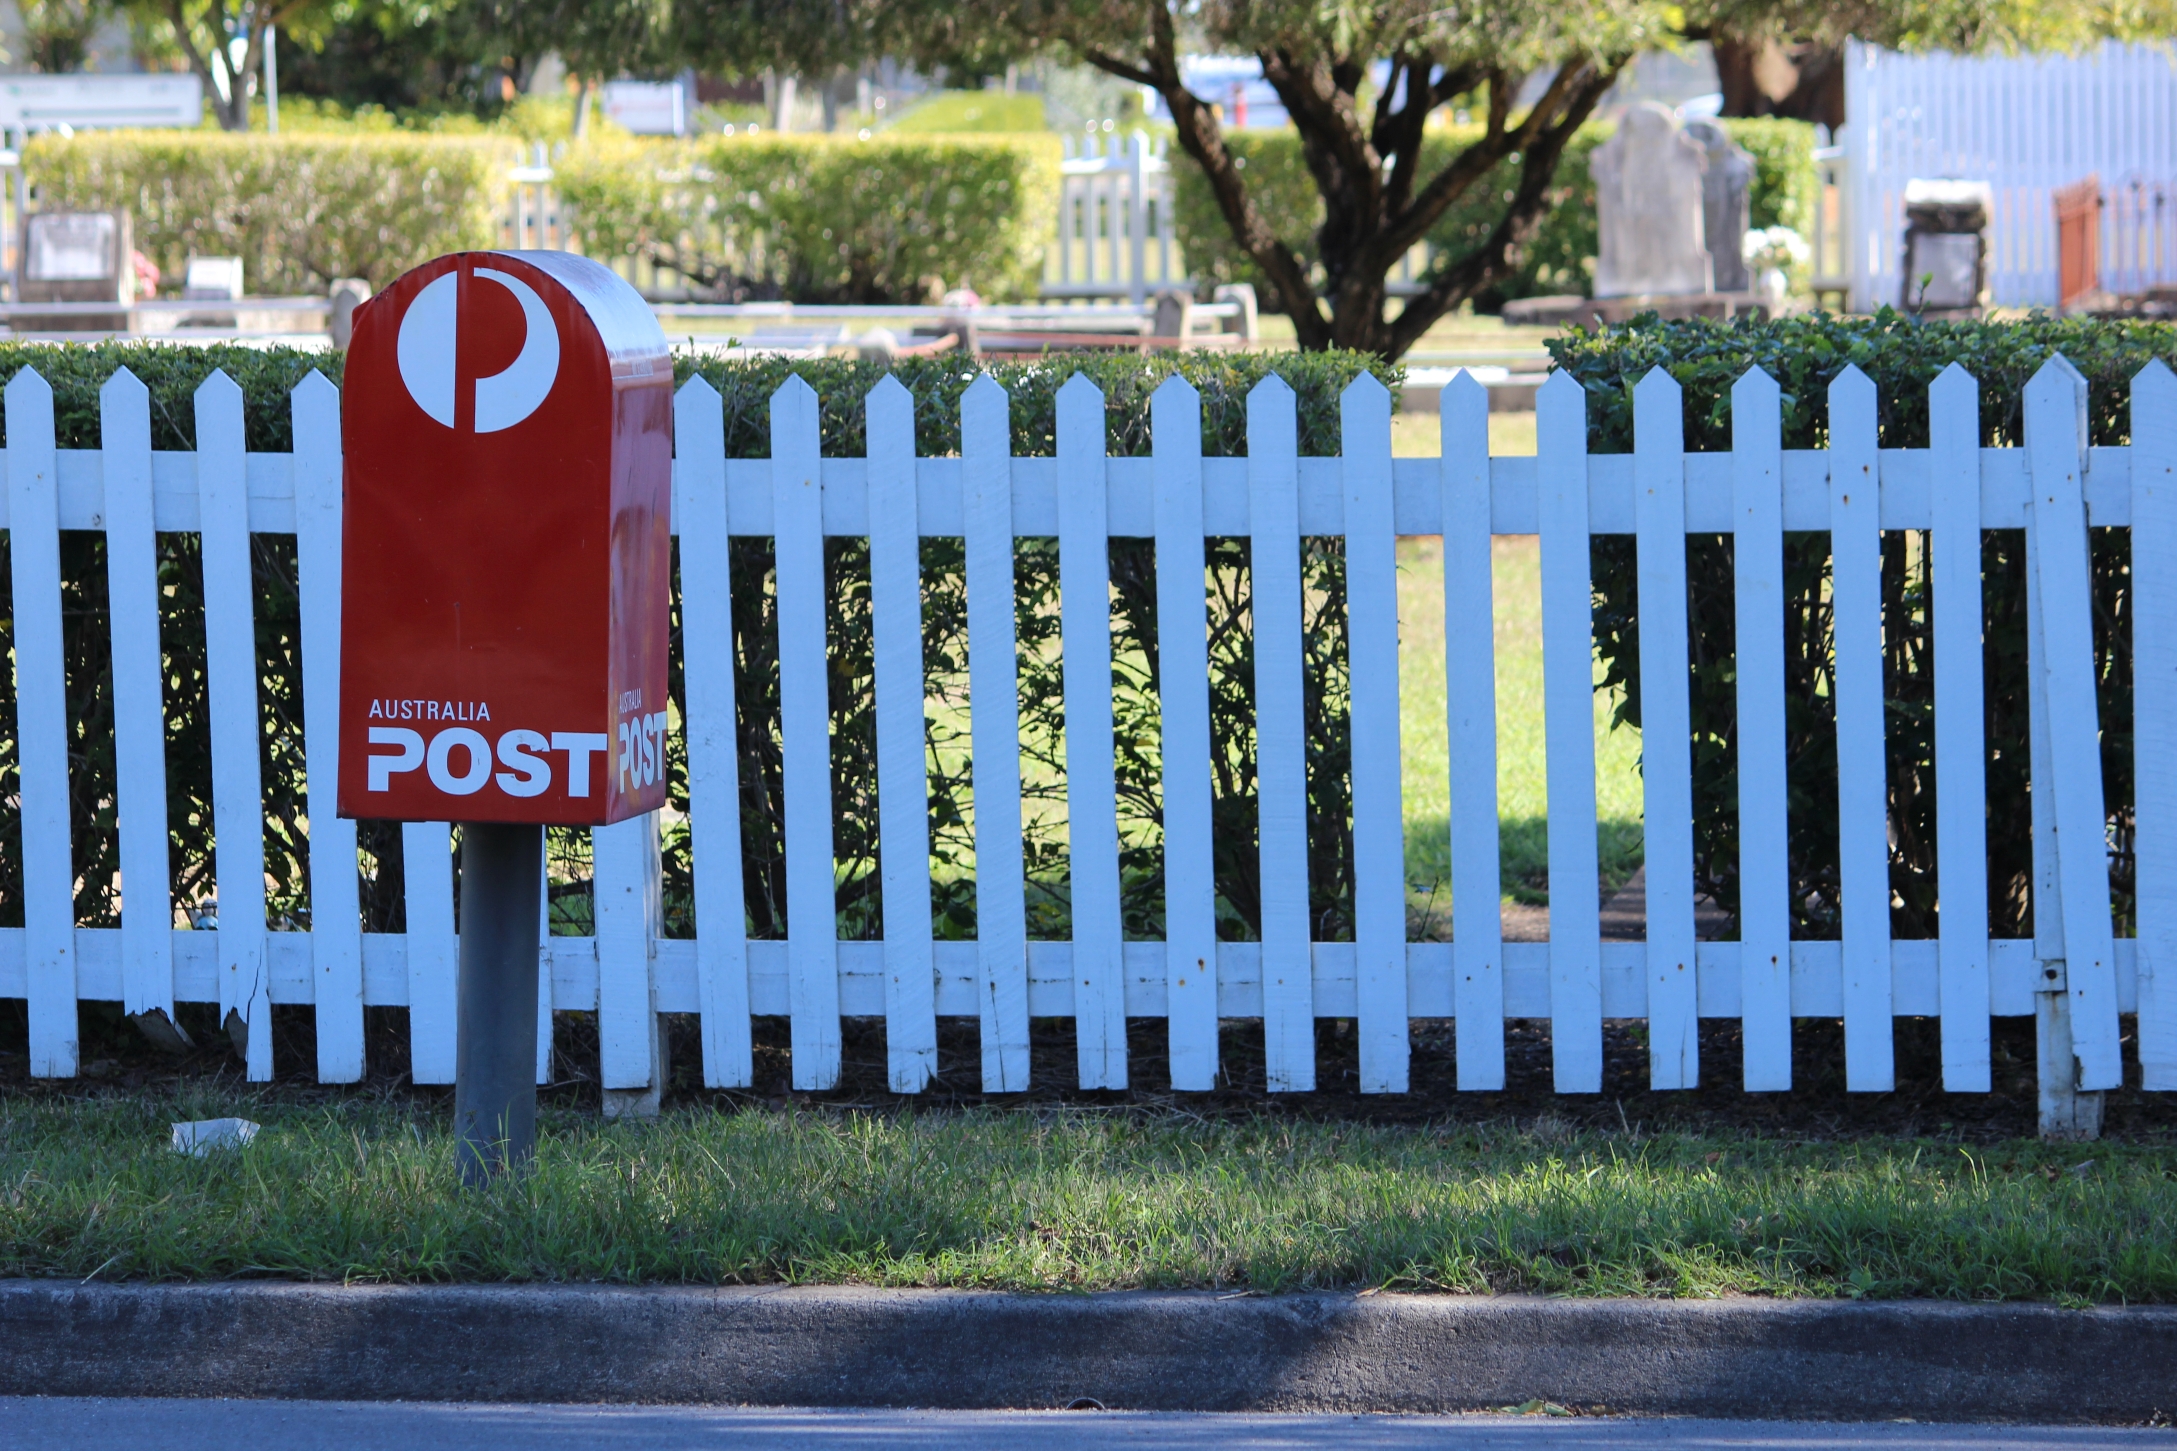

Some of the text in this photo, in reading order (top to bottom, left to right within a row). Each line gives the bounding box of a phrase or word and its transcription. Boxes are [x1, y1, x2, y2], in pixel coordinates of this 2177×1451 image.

[368, 698, 491, 722] AUSTRALIA
[619, 688, 642, 714] AUSTRALIA
[368, 726, 608, 798] POST
[619, 711, 667, 794] POST
